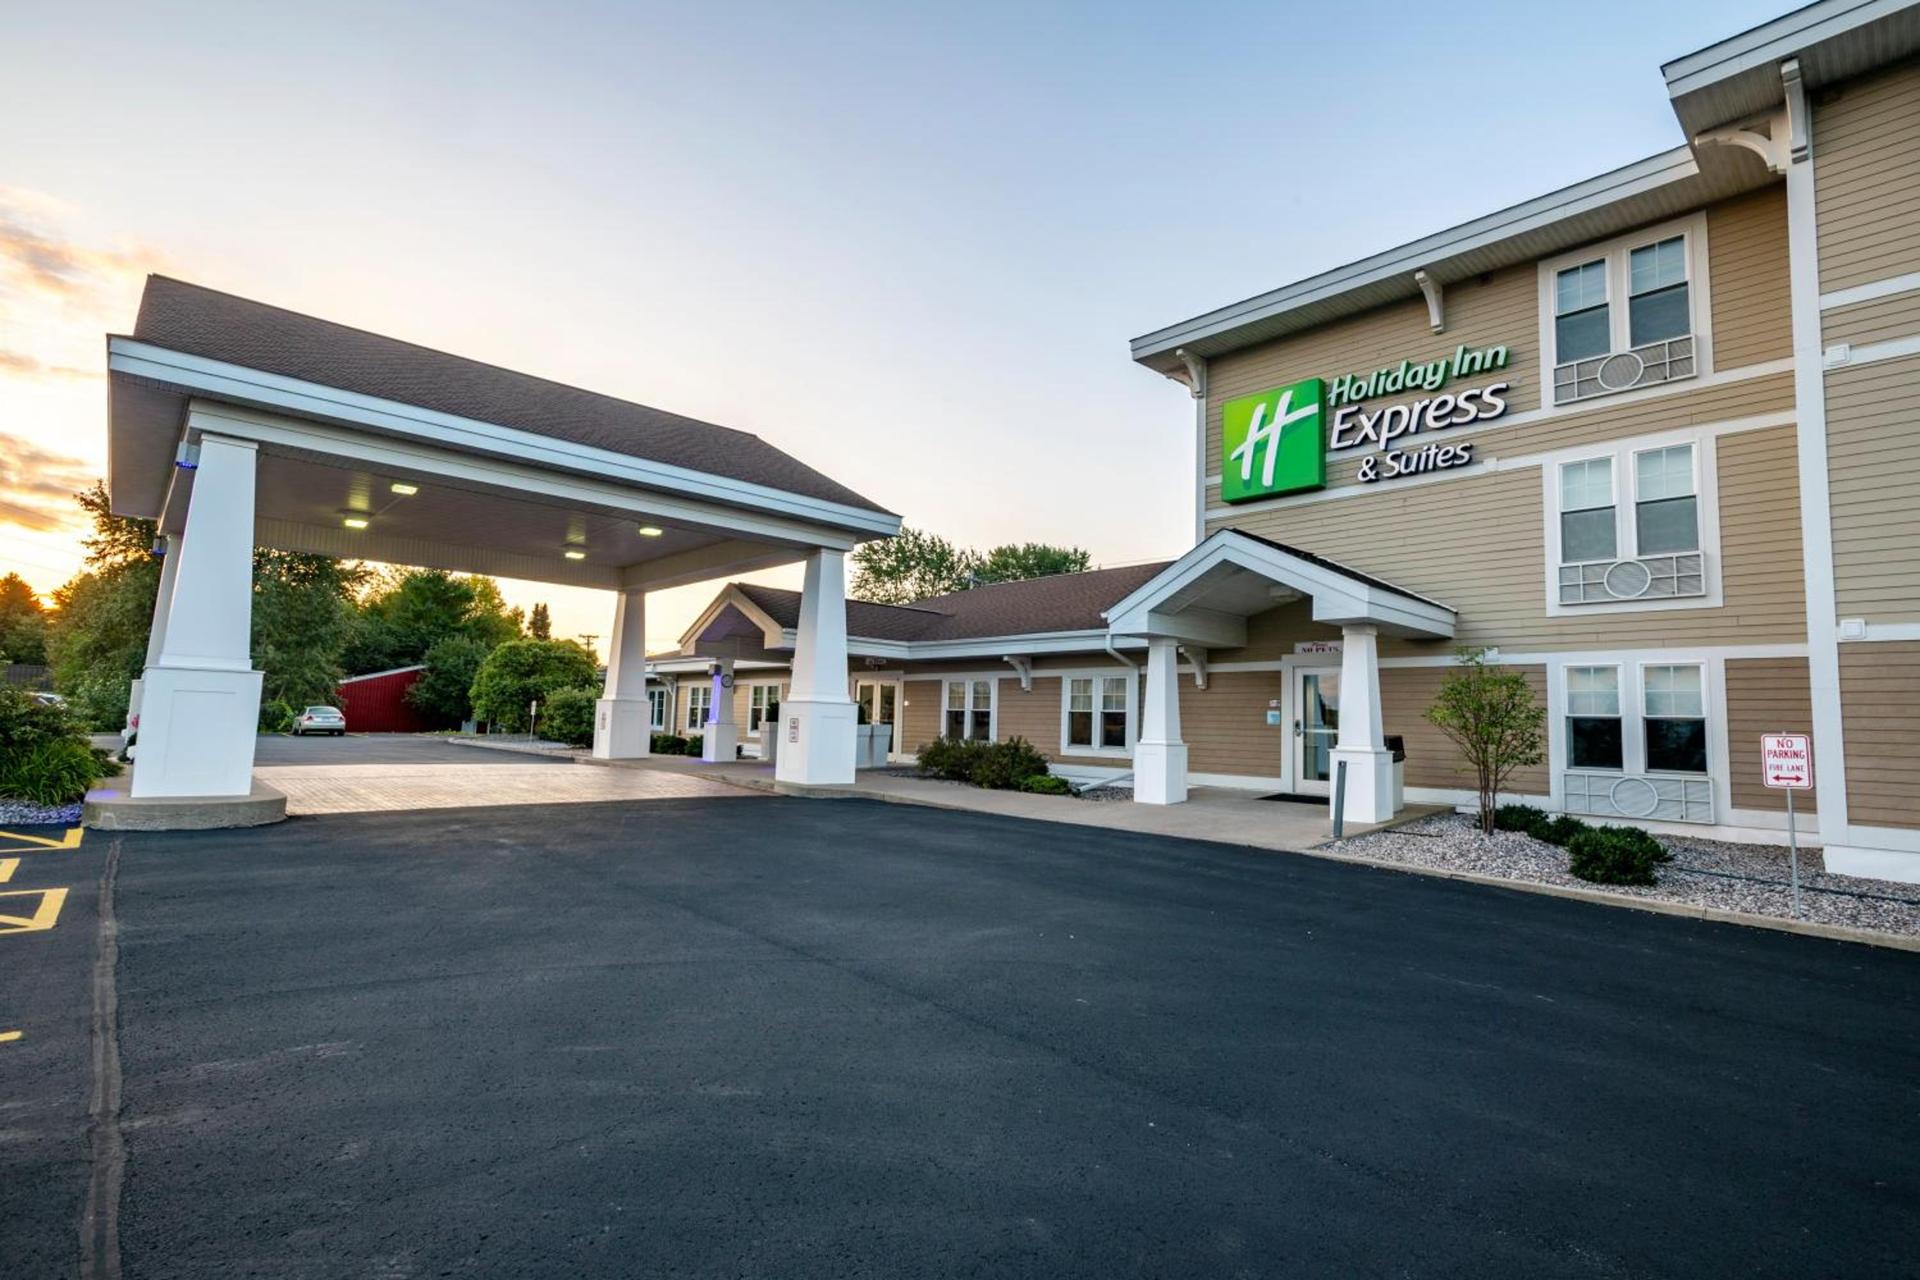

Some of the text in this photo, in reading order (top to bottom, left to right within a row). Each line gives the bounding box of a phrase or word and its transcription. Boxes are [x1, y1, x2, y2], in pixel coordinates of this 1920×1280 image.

[1328, 344, 1508, 406] Holiday Inn
[1330, 382, 1509, 450] Express
[1357, 442, 1471, 483] & Suites
[1767, 750, 1805, 759] PARKING
[1777, 739, 1793, 748] NO
